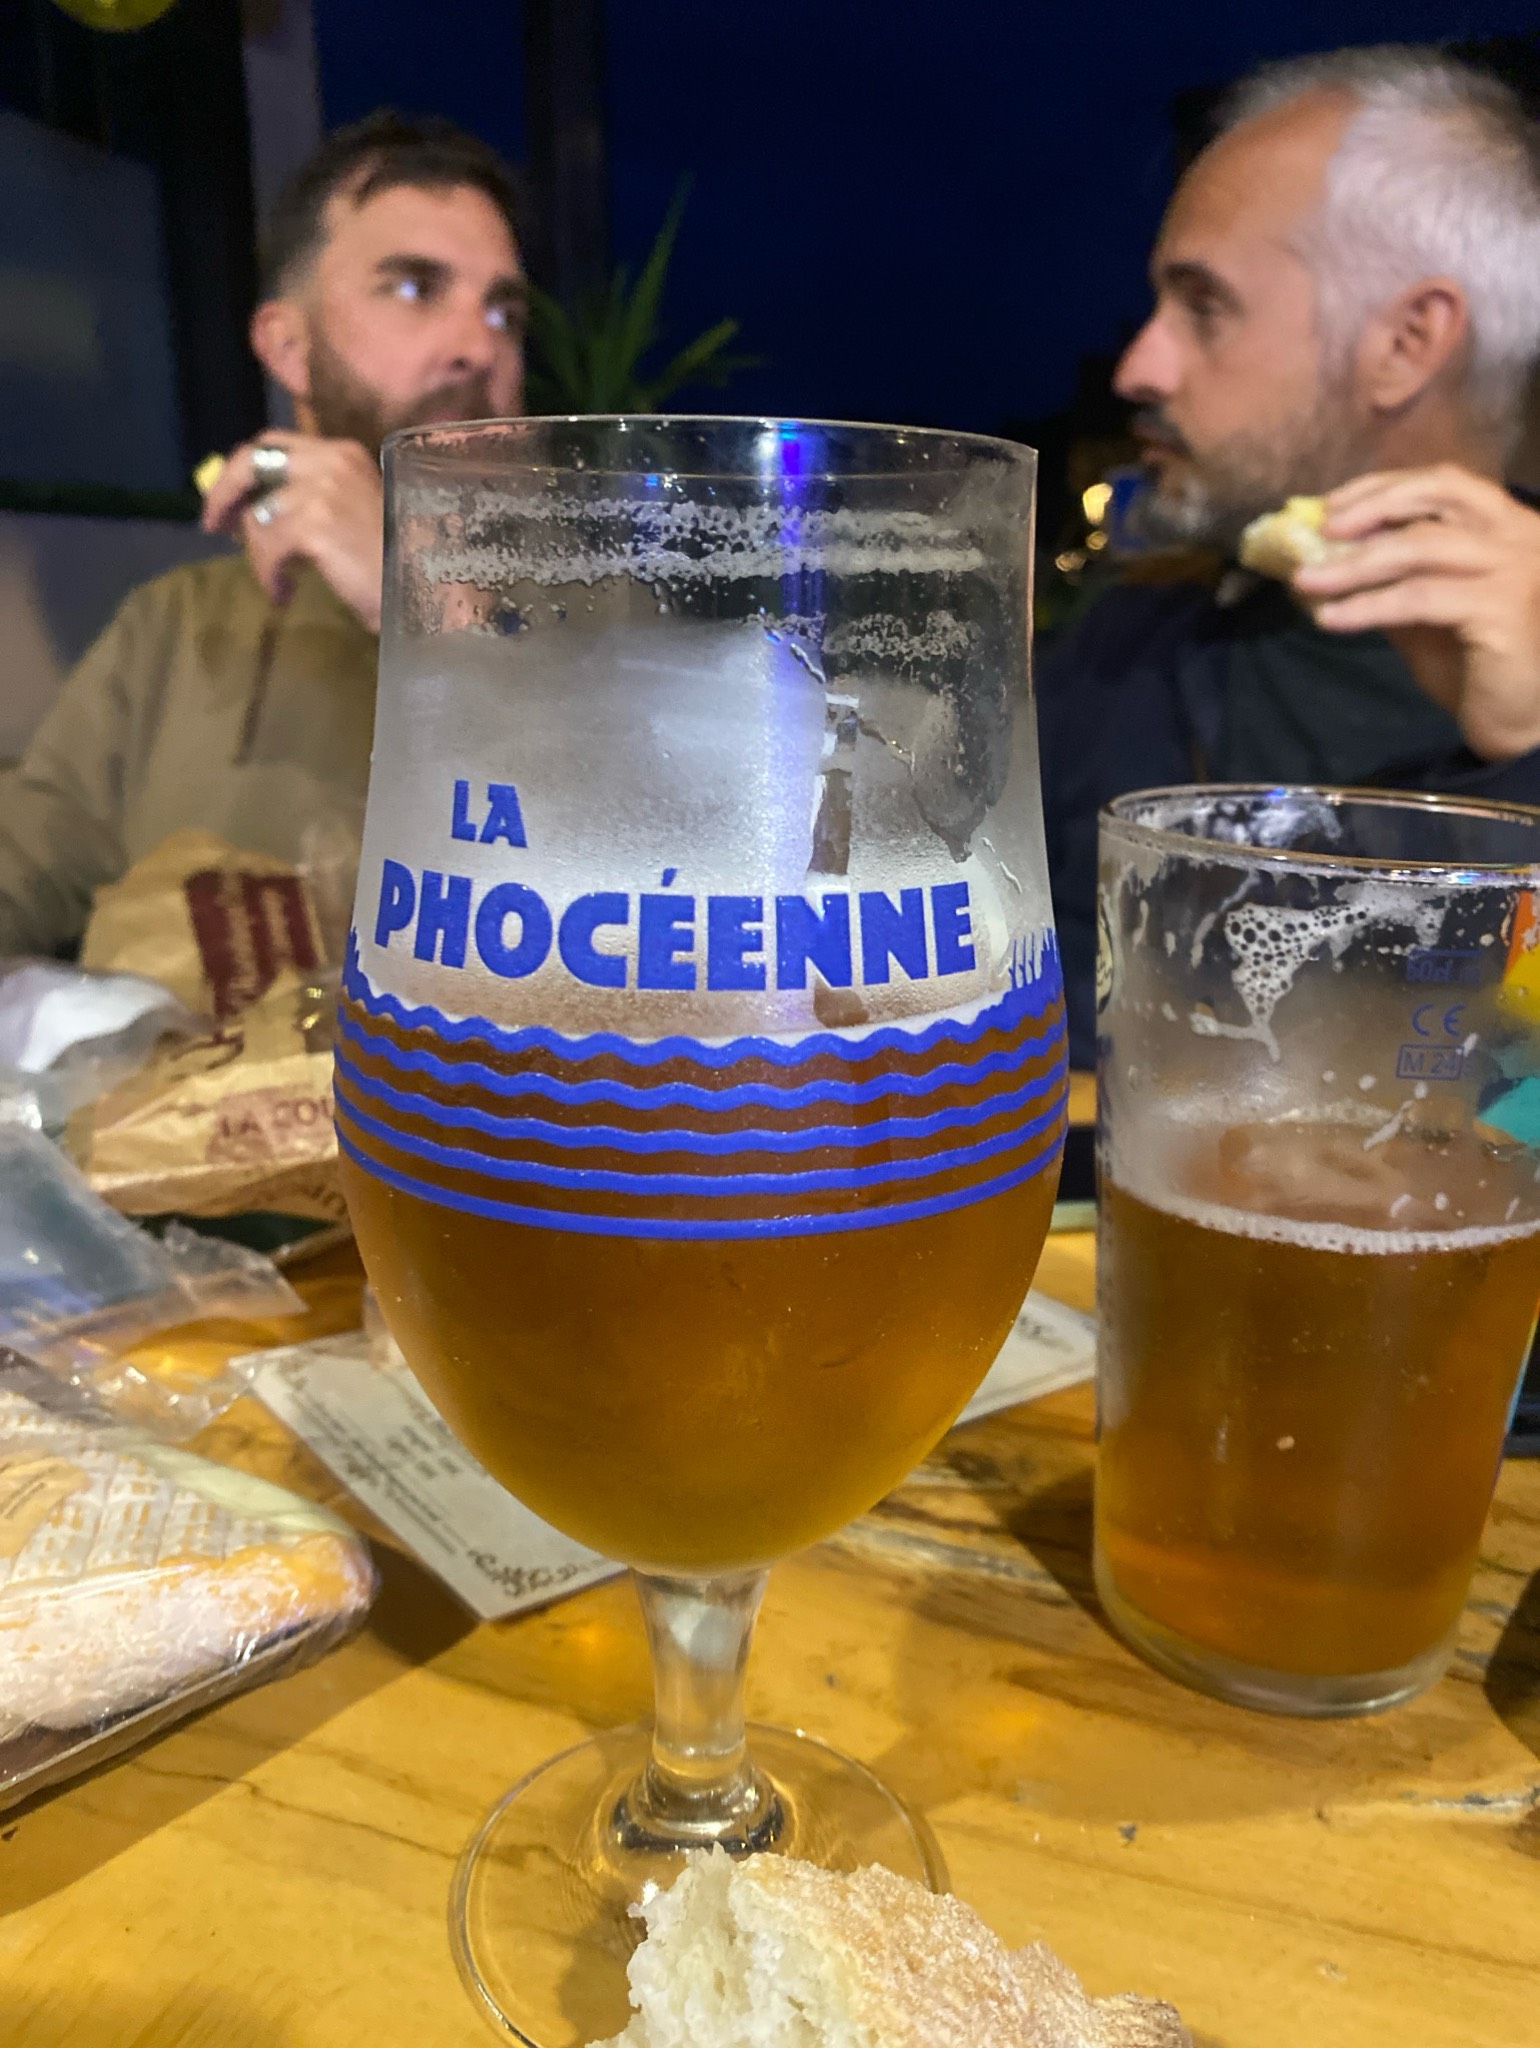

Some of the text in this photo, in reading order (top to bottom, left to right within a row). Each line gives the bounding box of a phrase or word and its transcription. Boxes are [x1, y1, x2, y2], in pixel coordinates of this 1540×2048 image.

[451, 779, 527, 848] LA
[374, 859, 976, 991] PHOCÉENNE
[1411, 1003, 1467, 1036] CE
[1403, 1052, 1425, 1072] M
